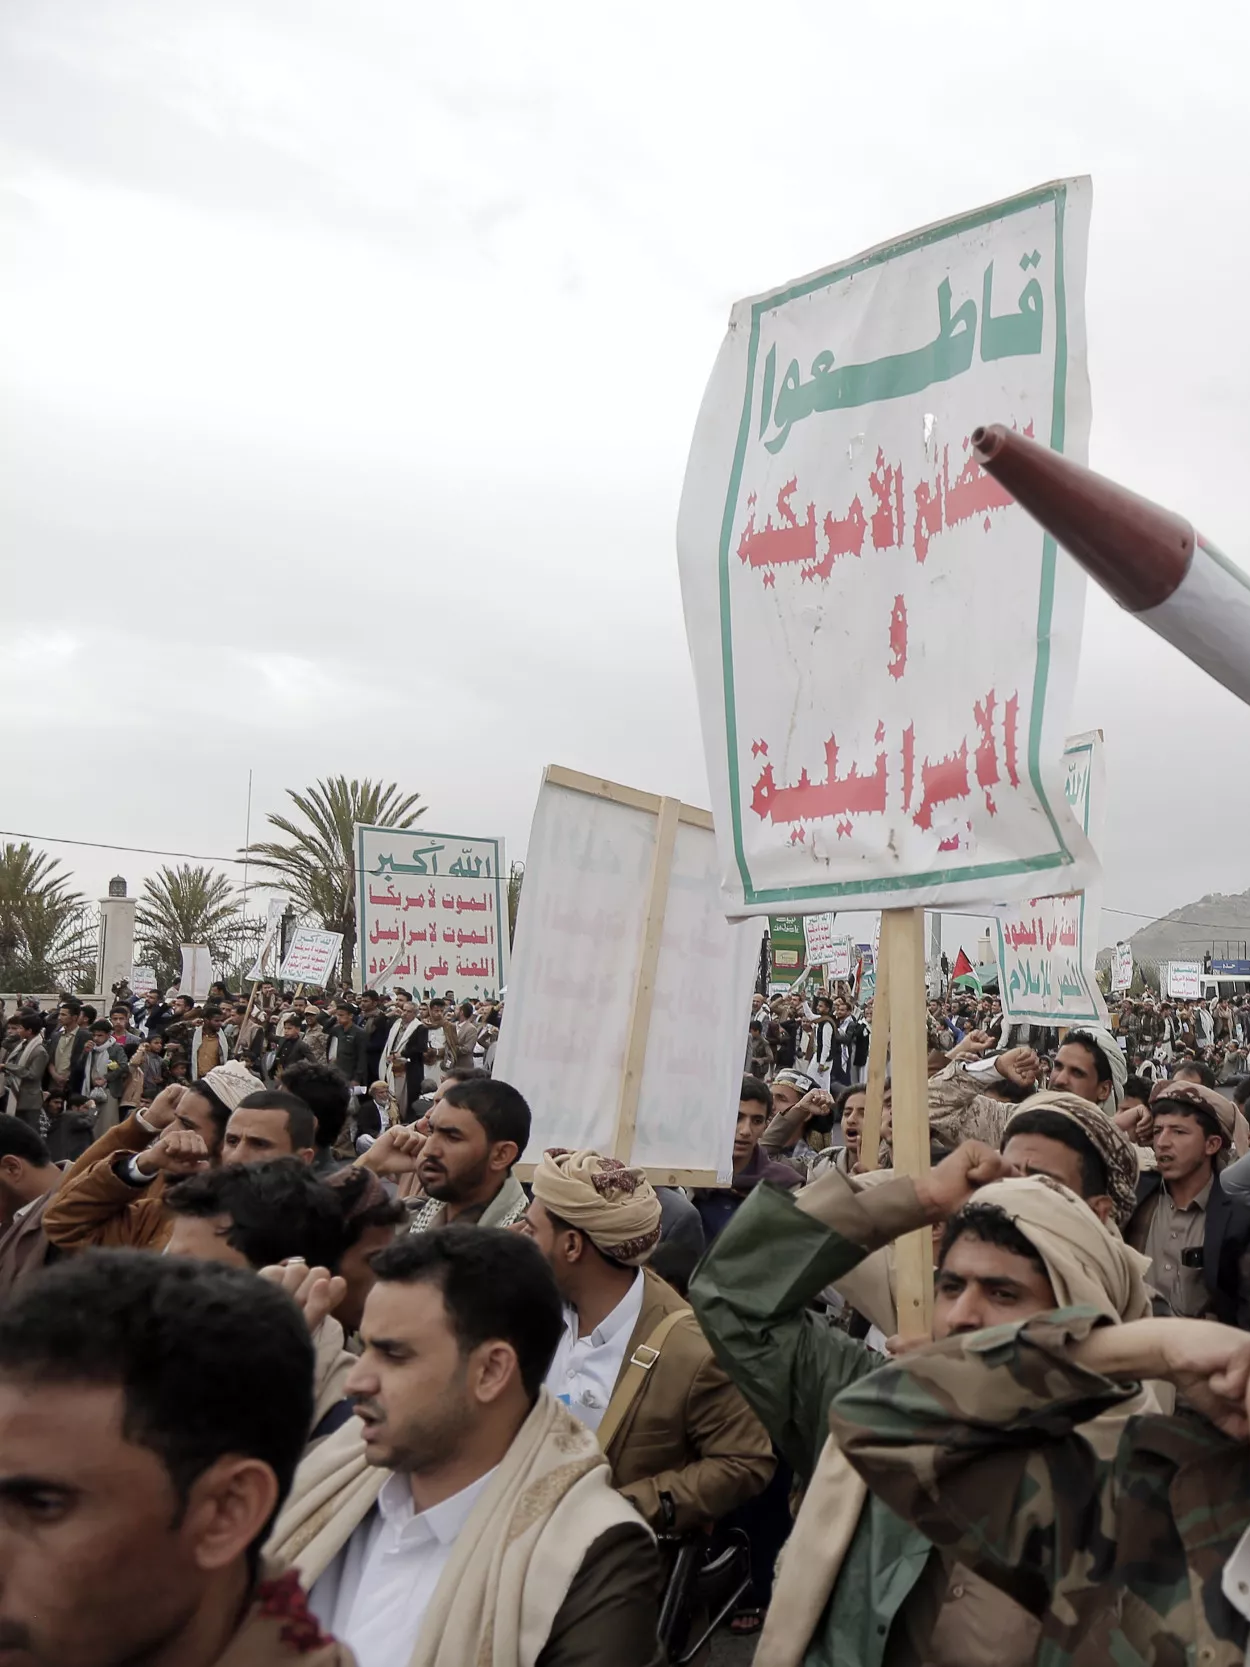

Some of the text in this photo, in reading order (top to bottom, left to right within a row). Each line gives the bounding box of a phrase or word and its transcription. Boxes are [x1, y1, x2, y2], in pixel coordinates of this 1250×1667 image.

[758, 249, 1044, 455] قاطعوا
[737, 445, 906, 590] الأمريكية
[887, 593, 909, 682] و
[750, 689, 1021, 845] الإسرائيلية
[369, 840, 492, 882] الله أكبر
[368, 883, 493, 915] الموت لأمريكا
[368, 918, 495, 949] الموت لإسرائيل
[1004, 916, 1044, 952] اليهود
[423, 955, 449, 981] على
[455, 955, 495, 978] اللعنة
